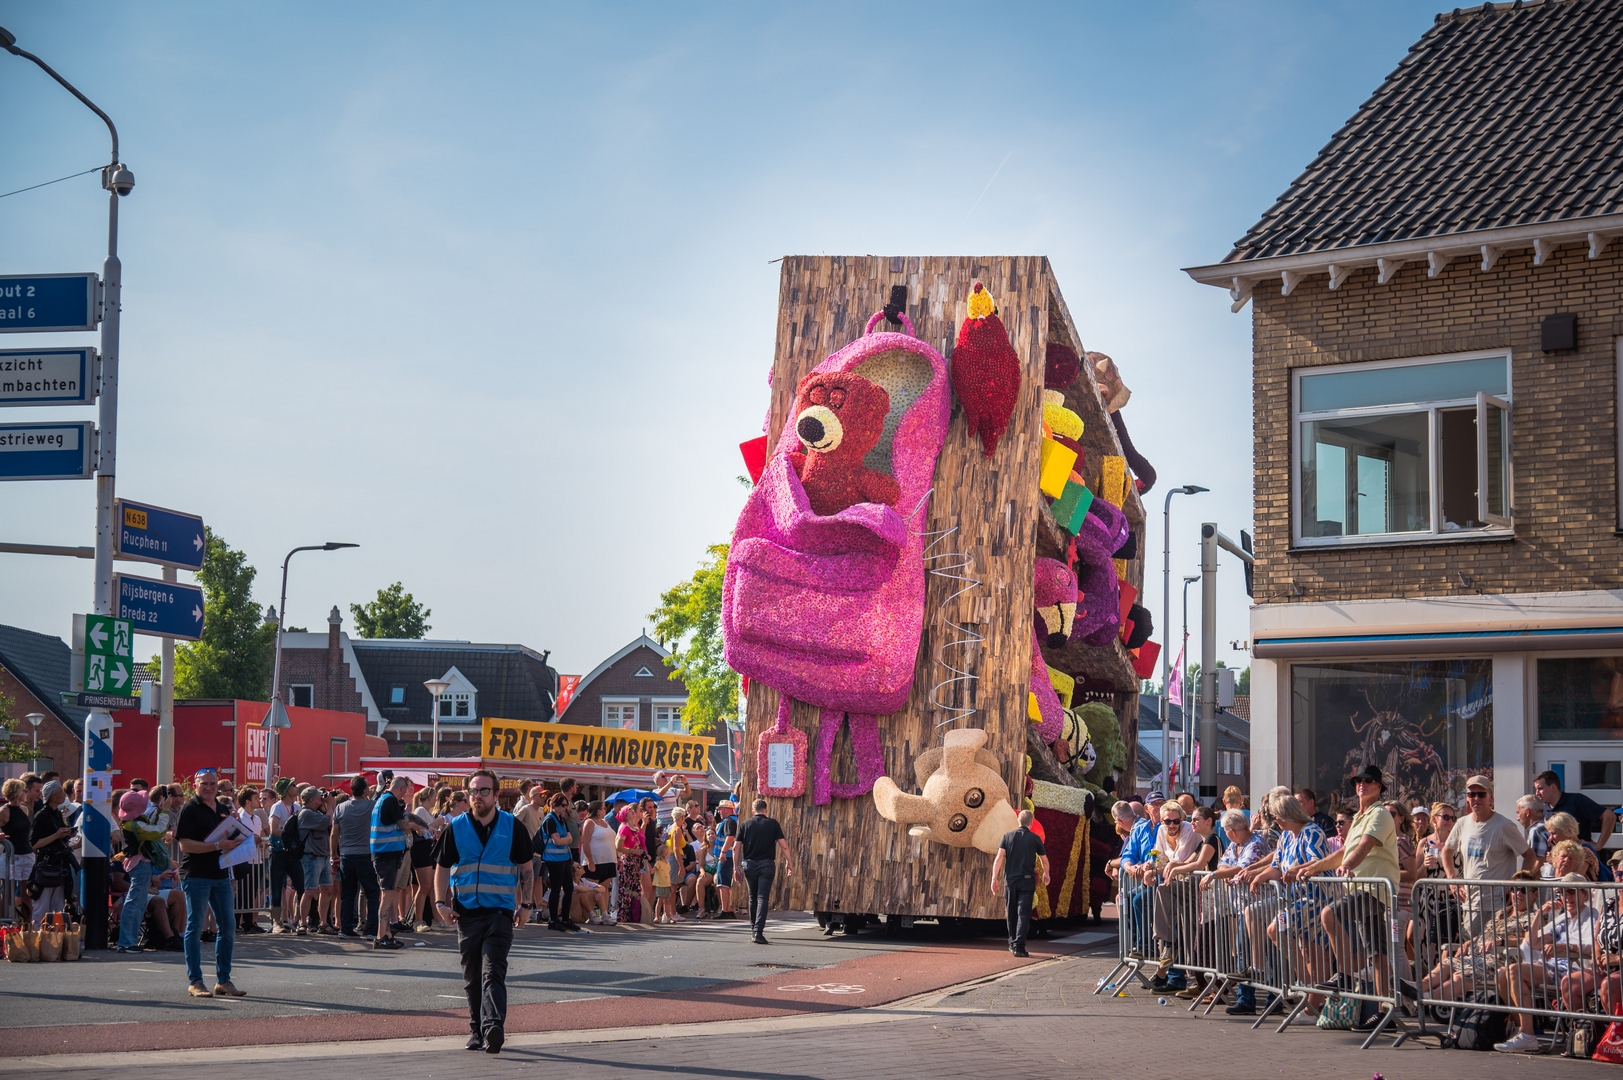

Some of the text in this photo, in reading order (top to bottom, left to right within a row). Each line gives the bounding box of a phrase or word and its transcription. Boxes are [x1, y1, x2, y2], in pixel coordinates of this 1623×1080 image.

[26, 285, 36, 297] 2
[27, 307, 36, 319] 6
[0, 379, 76, 393] mbachten
[123, 531, 168, 552] Rucphen 11
[121, 583, 174, 605] Rijsbergen 6
[121, 605, 158, 623] Breda 22
[83, 695, 136, 708] PRINSENSTRAAT
[784, 760, 793, 774] SAM
